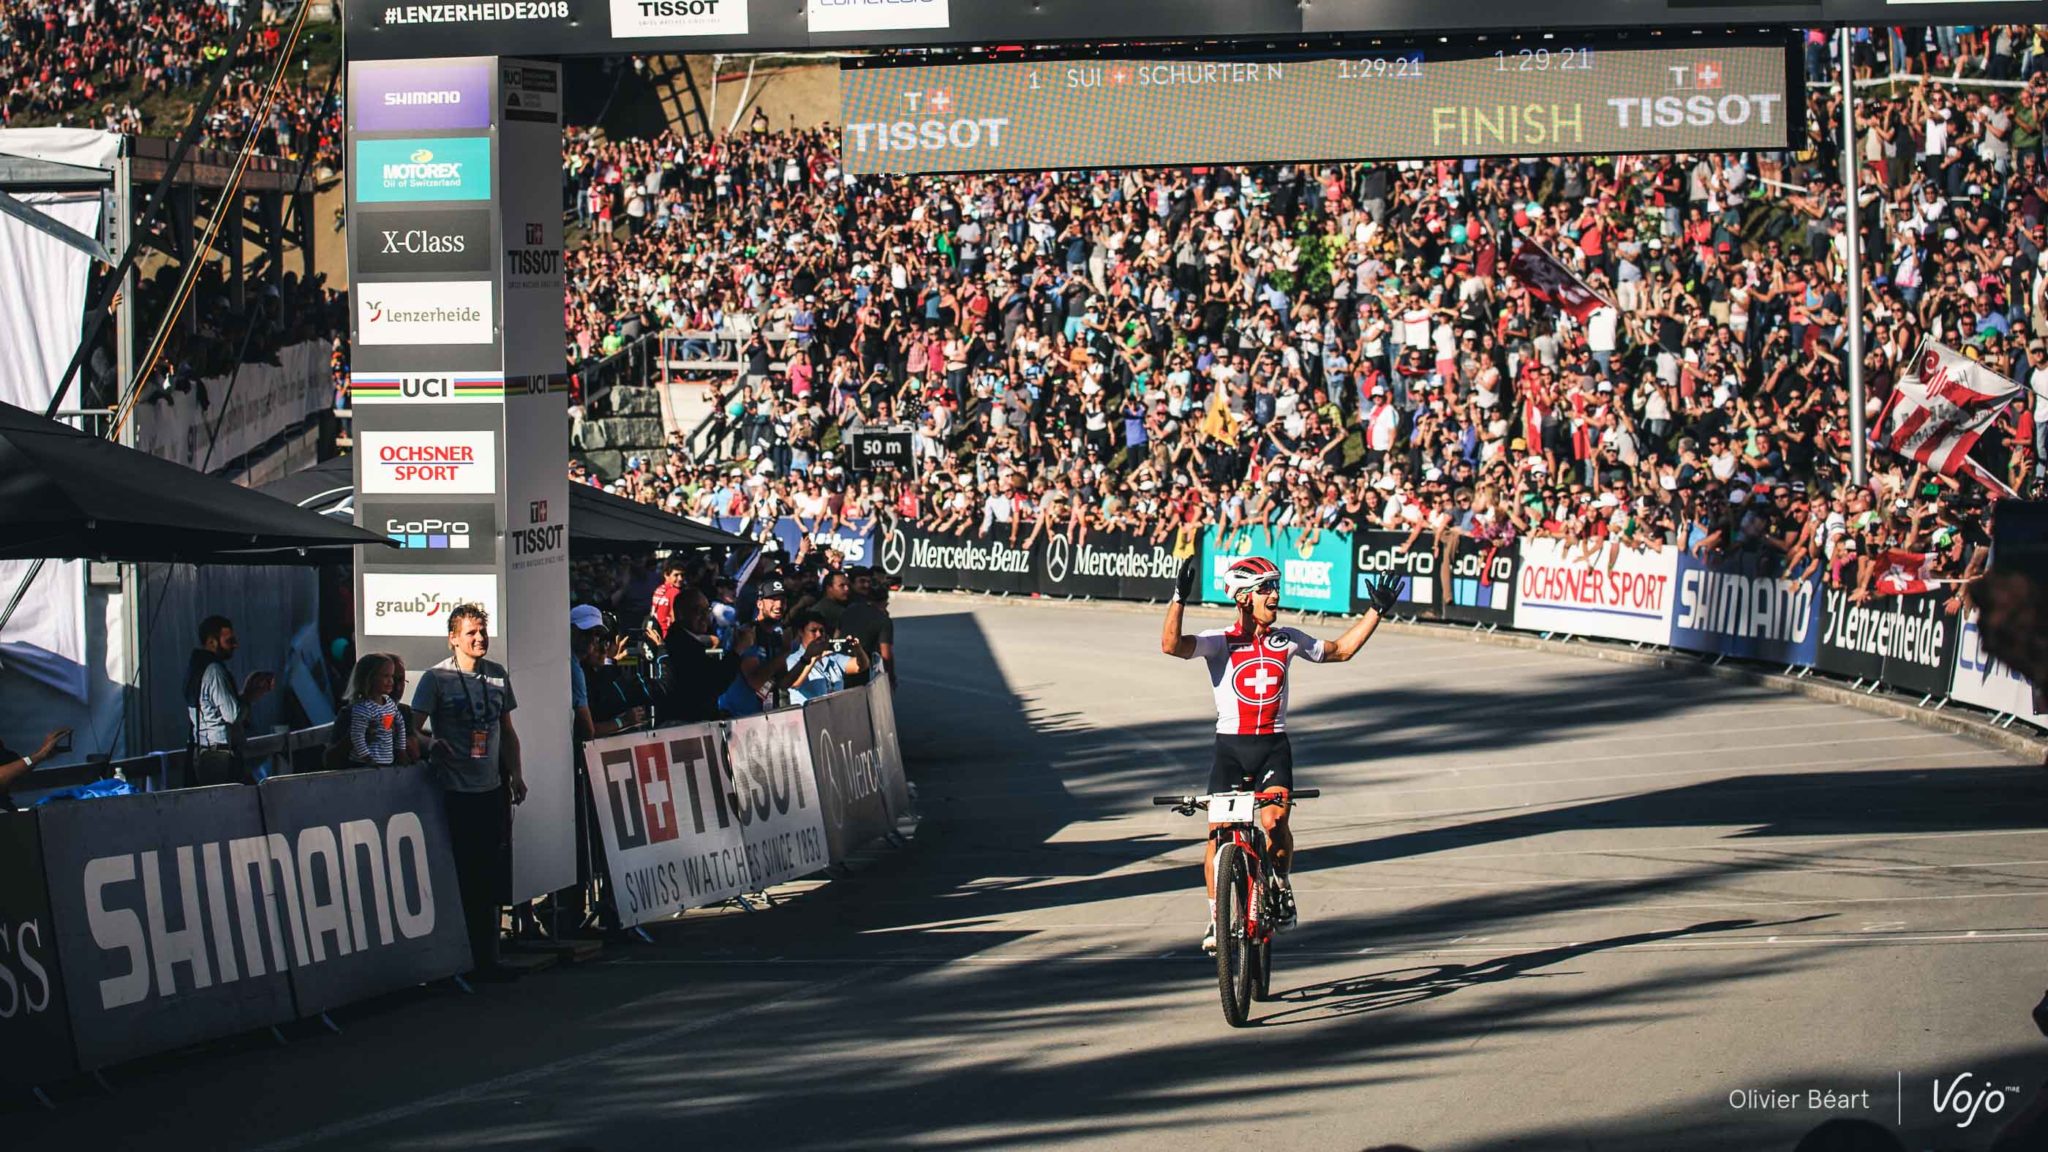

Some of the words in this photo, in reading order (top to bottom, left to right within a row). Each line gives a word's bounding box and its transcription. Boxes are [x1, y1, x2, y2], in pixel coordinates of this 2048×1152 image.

[384, 2, 570, 24] #LENZERHEIDE2018
[638, 0, 719, 17] TISSOT
[1337, 57, 1423, 79] 1:29:21
[1494, 47, 1592, 72] 1:29:21
[1029, 71, 1041, 89] 1
[1067, 67, 1101, 88] SUI
[1139, 63, 1257, 85] SCHURTER
[1268, 62, 1283, 80] N
[384, 90, 461, 105] SHIMANO
[1608, 93, 1781, 129] TISSOT
[846, 117, 1009, 153] TISSOT
[1432, 103, 1583, 147] FINISH
[383, 163, 462, 180] MOTOREX
[399, 180, 407, 188] of
[409, 179, 461, 188] Switzerland
[381, 229, 465, 254] X-Class
[508, 250, 560, 276] TISSOT
[387, 307, 481, 323] Lenzerheide
[402, 378, 448, 398] UCI
[527, 374, 547, 395] UCI
[379, 445, 474, 461] OCHSNER
[863, 440, 882, 455] 50
[886, 441, 902, 454] m
[394, 465, 459, 481] SPORT
[386, 519, 470, 534] GoPro
[512, 523, 564, 555] TISSOT
[910, 537, 1030, 574] Mercedes-Benz
[1073, 544, 1183, 579] Mercedes-Ben
[1358, 544, 1434, 574] GoPro
[1522, 564, 1604, 605] OCHSNER
[1611, 570, 1667, 611] SPORT
[1677, 567, 1814, 644] SHIMANO
[1835, 594, 1944, 668] Lenzerheide
[669, 719, 807, 834] TISSOT
[1228, 798, 1236, 812] 1
[625, 860, 682, 915] SWISS
[682, 846, 762, 898] WATCHES
[762, 831, 795, 879] SINCE
[796, 825, 822, 865] 1853
[83, 811, 436, 1010] SHIMANO
